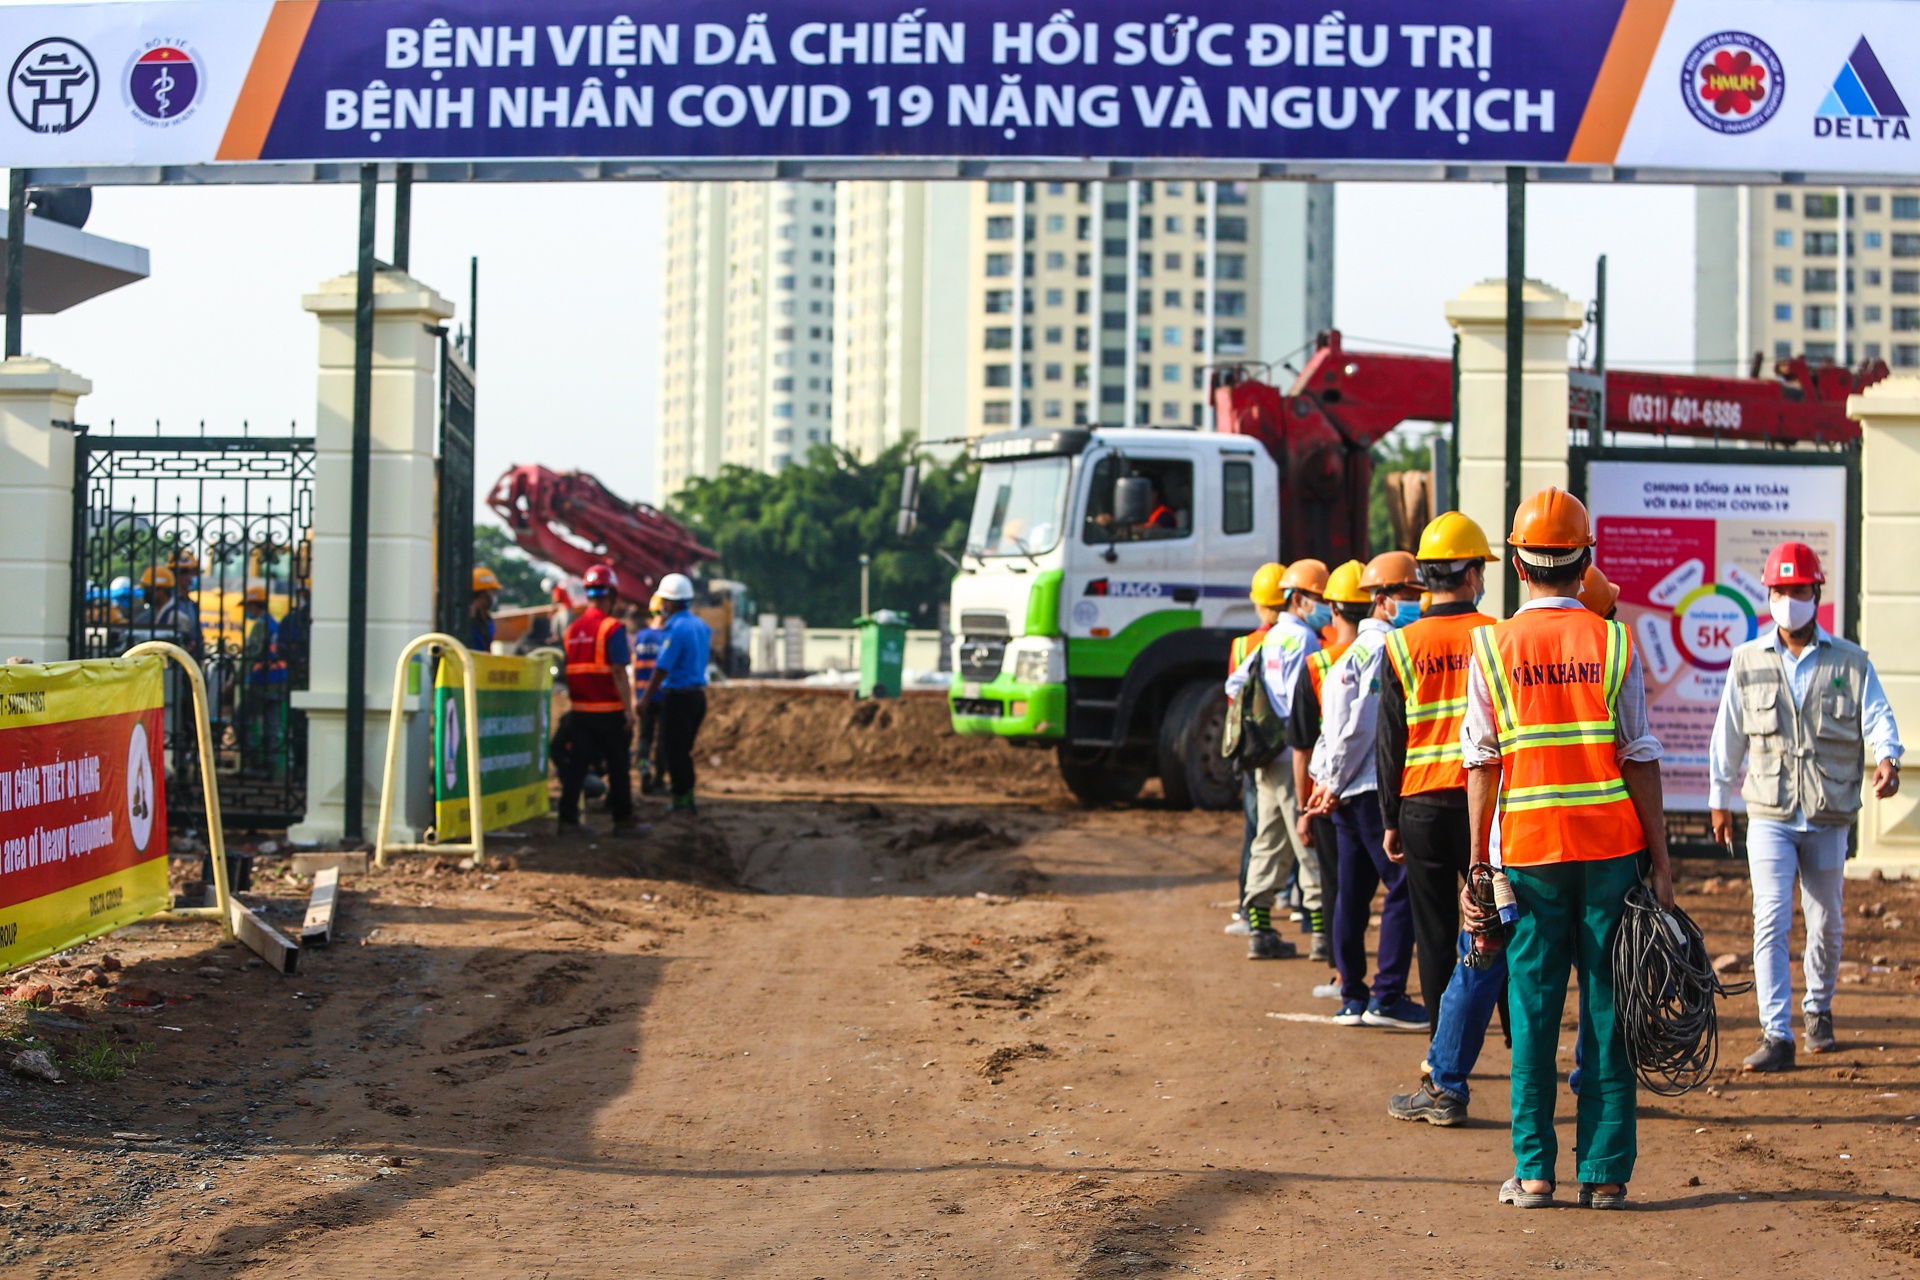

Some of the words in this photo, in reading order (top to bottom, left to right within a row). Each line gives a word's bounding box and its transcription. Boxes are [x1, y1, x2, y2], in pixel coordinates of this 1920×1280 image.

[385, 18, 535, 81] BỆNH
[546, 15, 680, 79] VIỆN
[694, 12, 777, 65] DÃ
[790, 7, 966, 66] CHIẾN
[993, 8, 1099, 66] HỒI
[1113, 14, 1234, 67] SỨC
[1246, 10, 1389, 68] ĐIỀU
[1400, 25, 1492, 82] TRỊ
[1709, 74, 1756, 91] HMUH
[325, 79, 475, 143] BỆNH
[488, 77, 654, 129] NHÂN
[667, 84, 851, 128] COVID
[867, 84, 934, 128] 19
[948, 74, 1121, 141] NẶNG
[1131, 76, 1213, 129] VÀ
[1227, 86, 1400, 131] NGUY
[1414, 87, 1556, 145] KỊCH
[1813, 117, 1912, 140] DELTA
[1628, 392, 1668, 424] (031)
[1643, 481, 1690, 494] CHUNG
[1694, 479, 1730, 494] SỐNG
[1734, 484, 1751, 495] AN
[1755, 481, 1789, 496] TOÀN
[1730, 500, 1790, 512] COVID-19
[1697, 625, 1732, 649] 5K
[1417, 652, 1444, 676] VÂN
[1446, 649, 1470, 672] KHÁ
[1512, 660, 1545, 687] VÂN
[1546, 656, 1602, 685] KHÁNH
[14, 761, 40, 810] CÔNG
[41, 750, 66, 804] THIẾT
[67, 759, 77, 805] BỊ
[4, 836, 27, 874] area
[29, 826, 39, 868] of
[40, 825, 68, 863] heavy
[68, 811, 114, 858] equipment
[89, 892, 105, 918] DELTA
[105, 886, 123, 911] GROUP
[0, 921, 18, 949] ROUP
